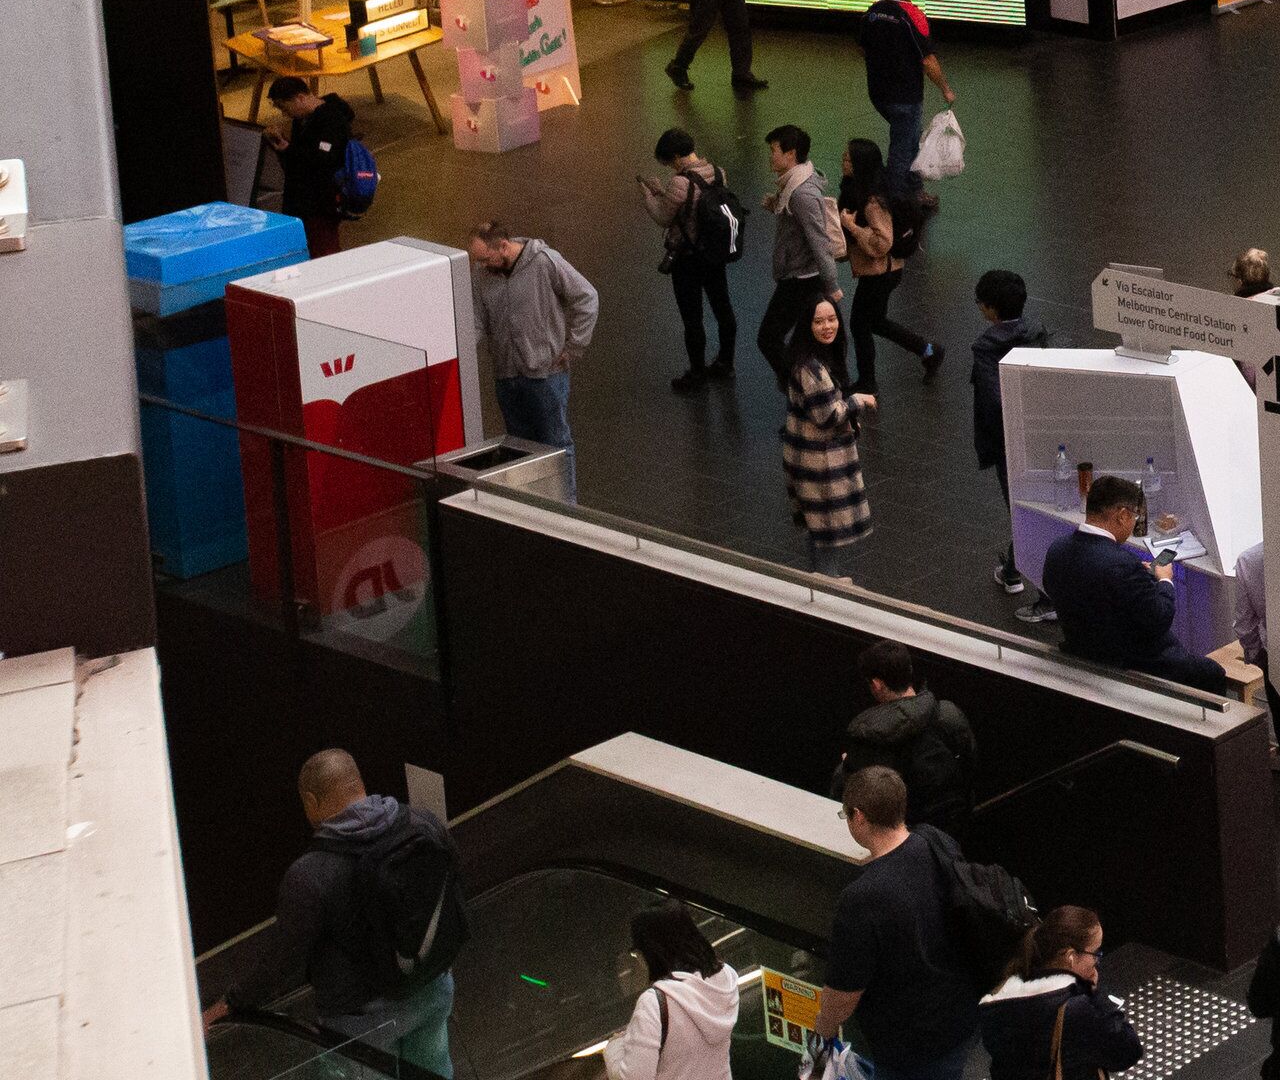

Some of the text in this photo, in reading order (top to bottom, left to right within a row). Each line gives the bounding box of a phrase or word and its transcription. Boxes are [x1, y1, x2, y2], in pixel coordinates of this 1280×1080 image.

[1115, 280, 1173, 302] Via Escalator
[1117, 296, 1237, 332] Melbourne Central Station
[1117, 312, 1234, 348] Lower Ground Food Court
